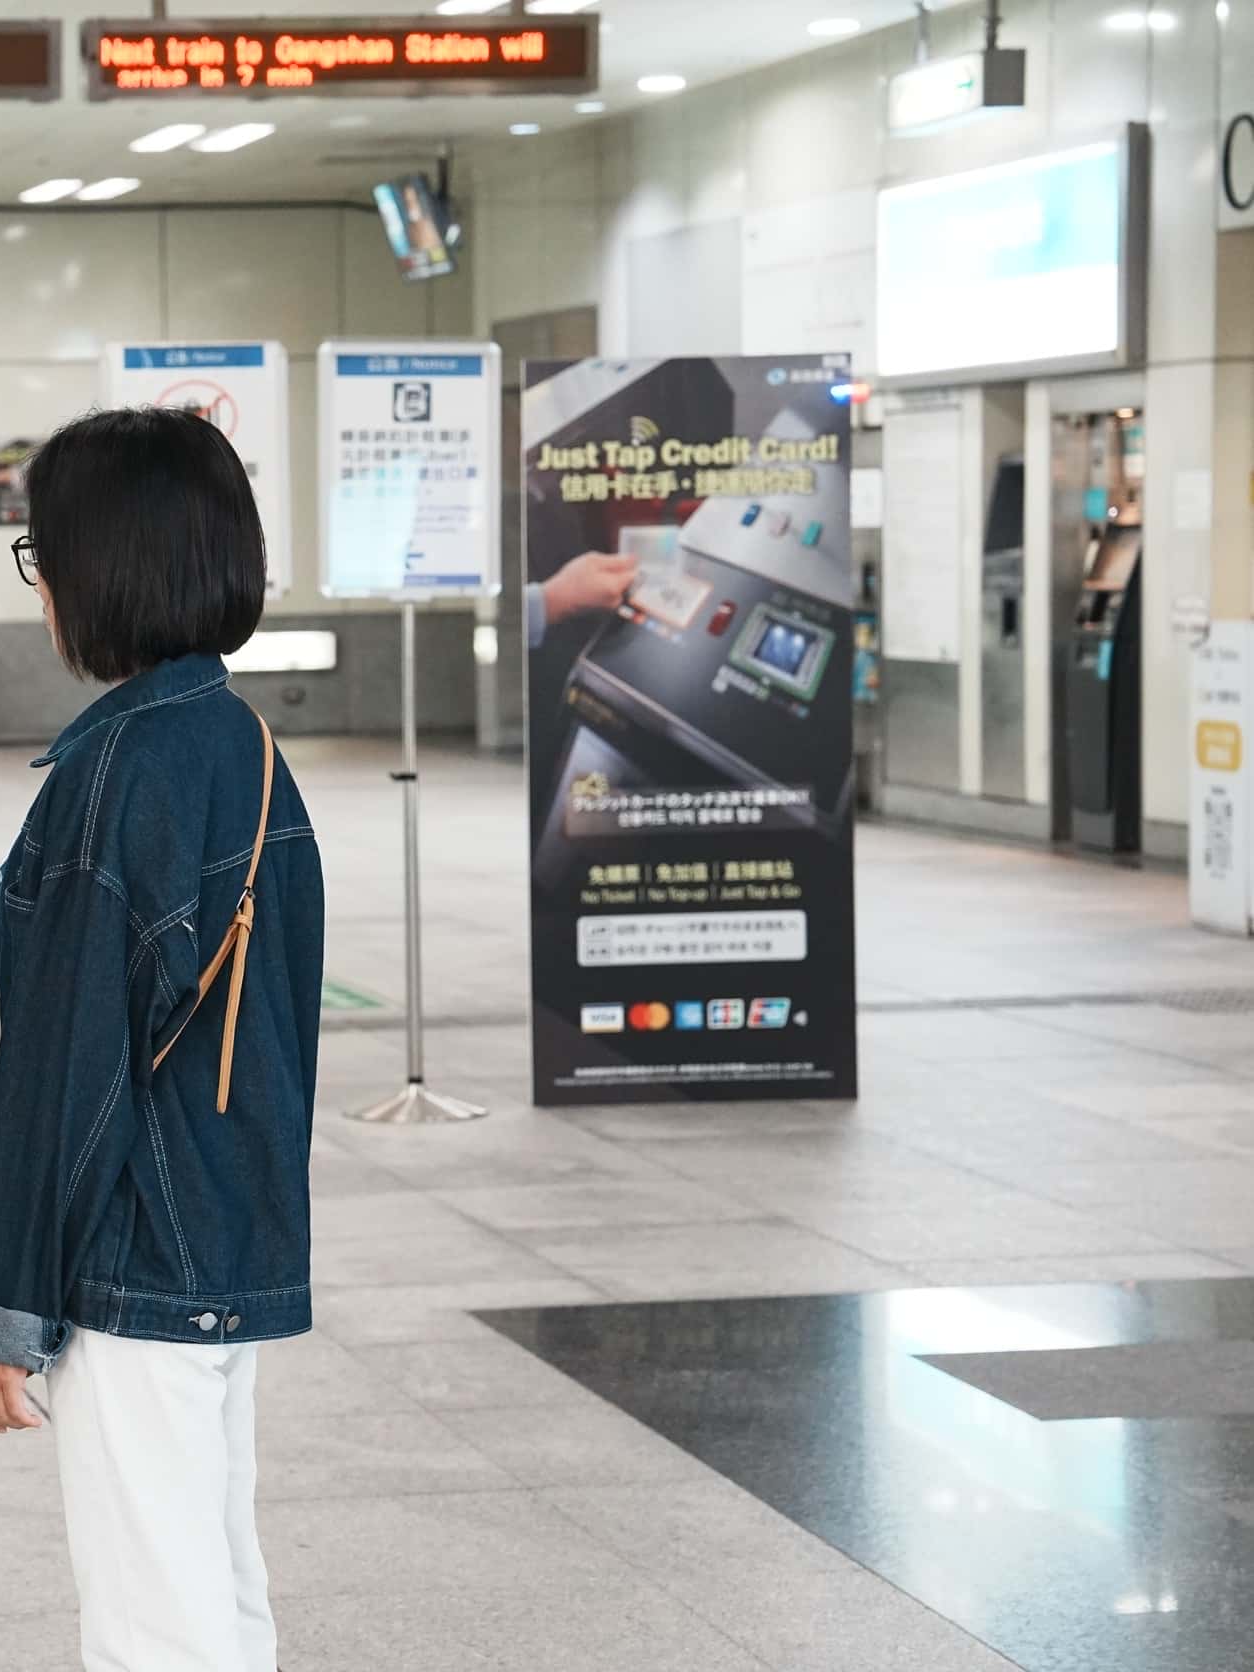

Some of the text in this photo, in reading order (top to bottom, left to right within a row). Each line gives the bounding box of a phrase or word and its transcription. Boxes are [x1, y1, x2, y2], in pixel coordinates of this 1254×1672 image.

[100, 36, 155, 67] Next
[167, 36, 224, 67] train
[236, 35, 263, 66] to
[404, 33, 489, 63] Station
[500, 32, 544, 61] will
[116, 66, 187, 88] arrive
[200, 65, 224, 87] in
[267, 64, 313, 87] min
[537, 434, 839, 471] Just Tap Credit Card!
